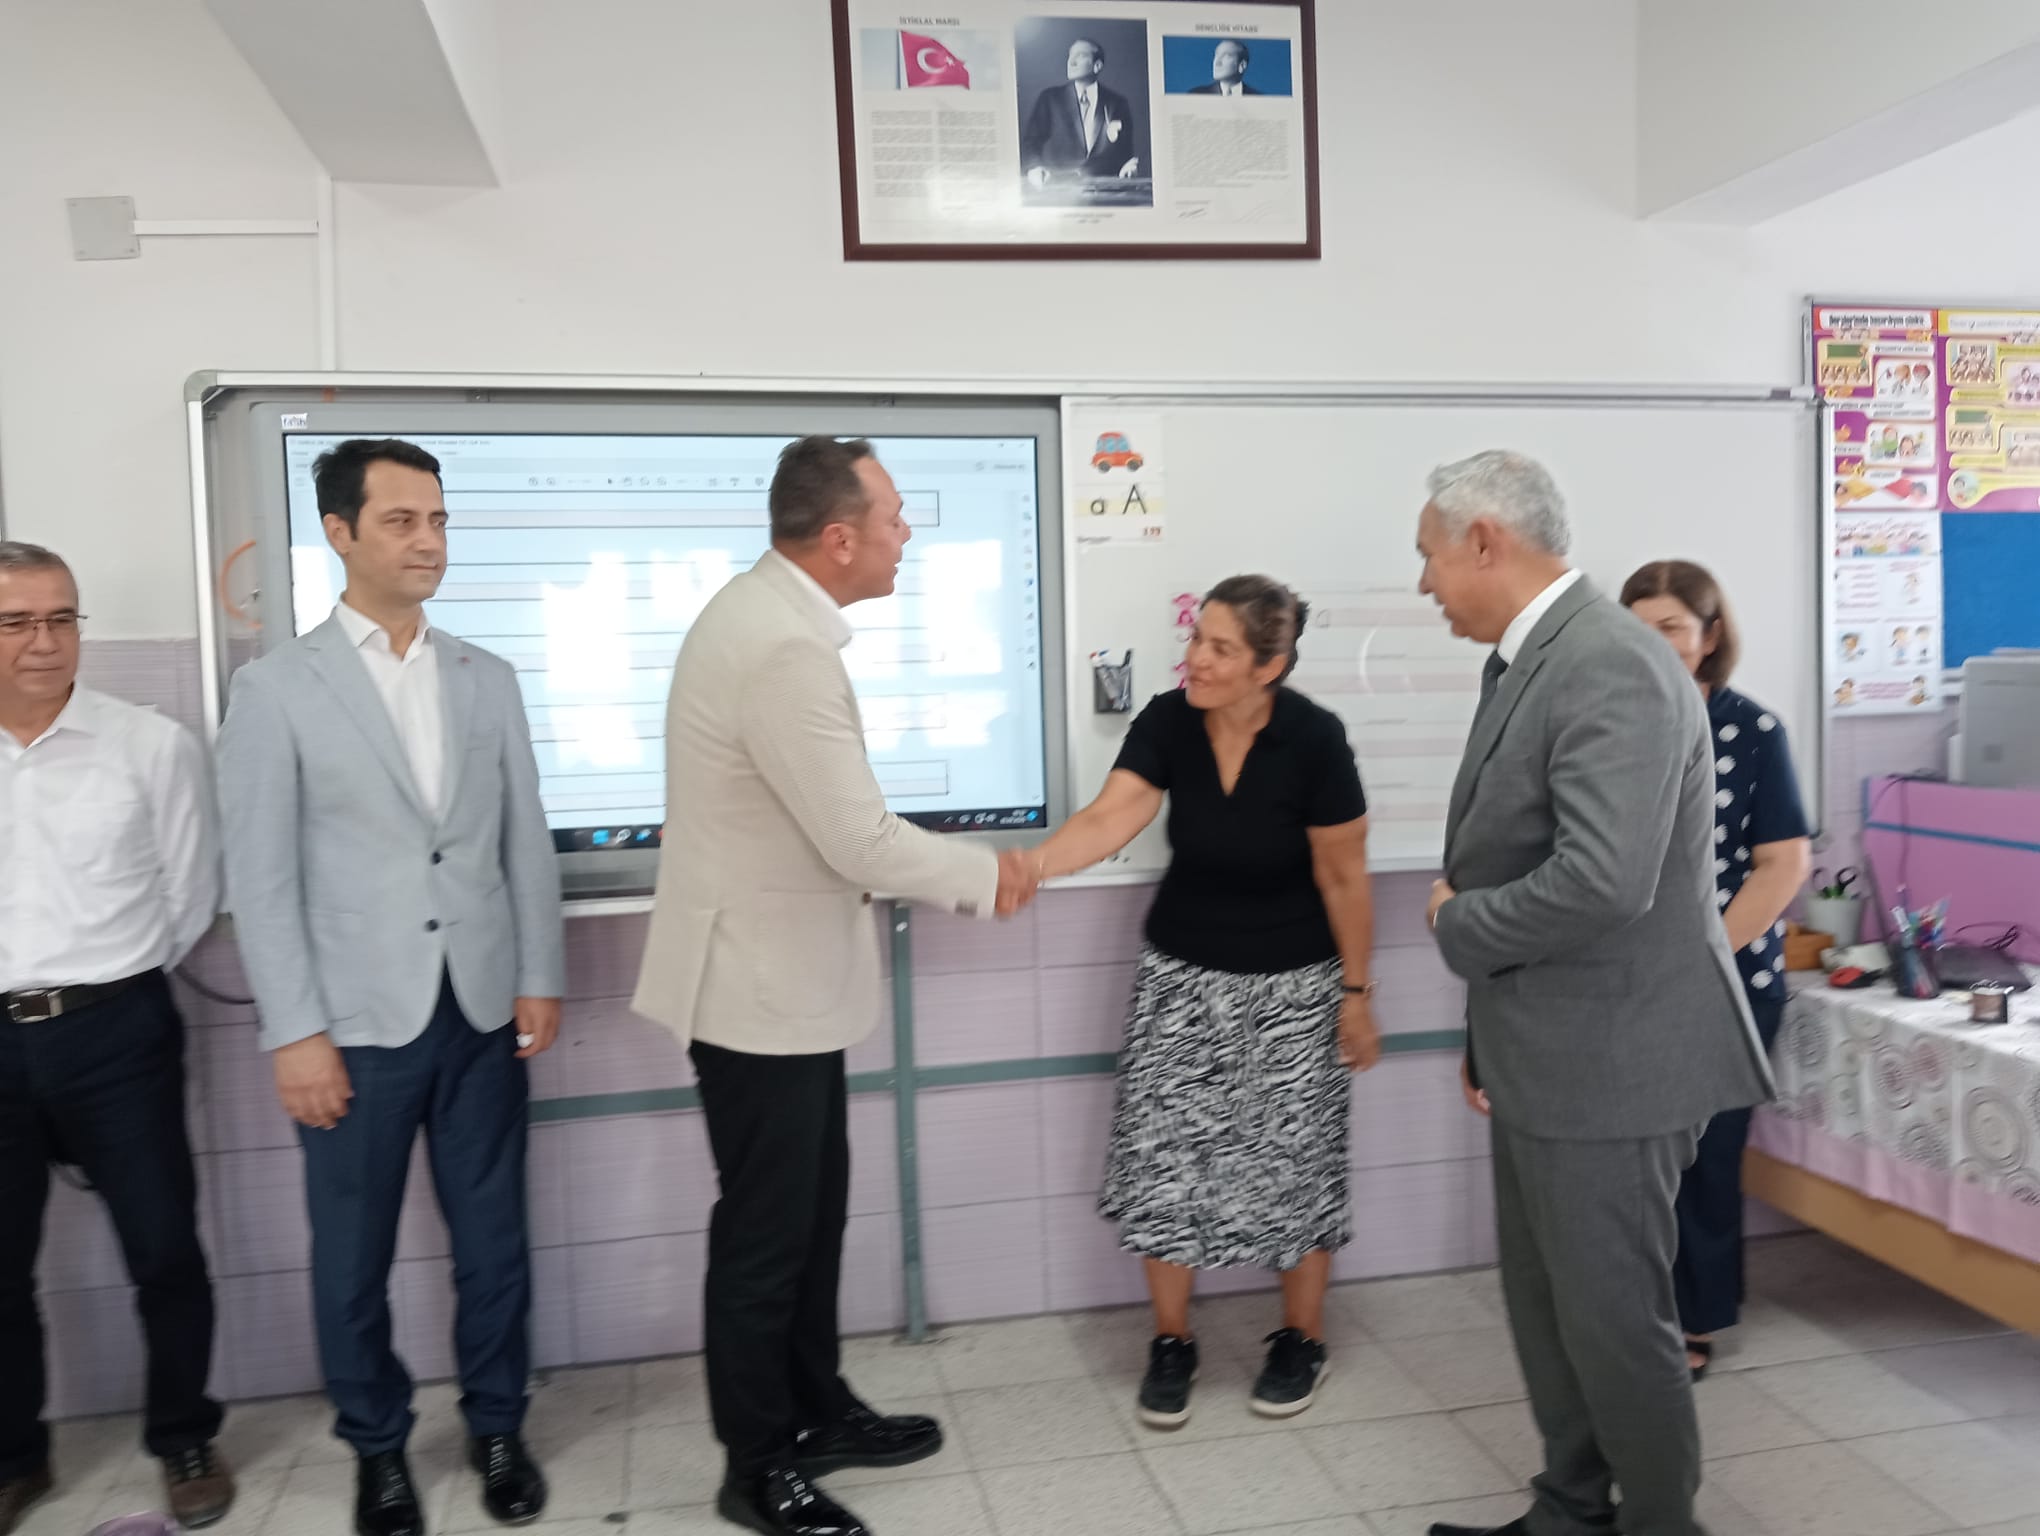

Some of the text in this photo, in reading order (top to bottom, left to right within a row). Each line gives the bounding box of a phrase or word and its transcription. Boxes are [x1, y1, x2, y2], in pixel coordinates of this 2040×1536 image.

[899, 15, 934, 25] İSTİKLAL
[1090, 483, 1147, 515] a A
